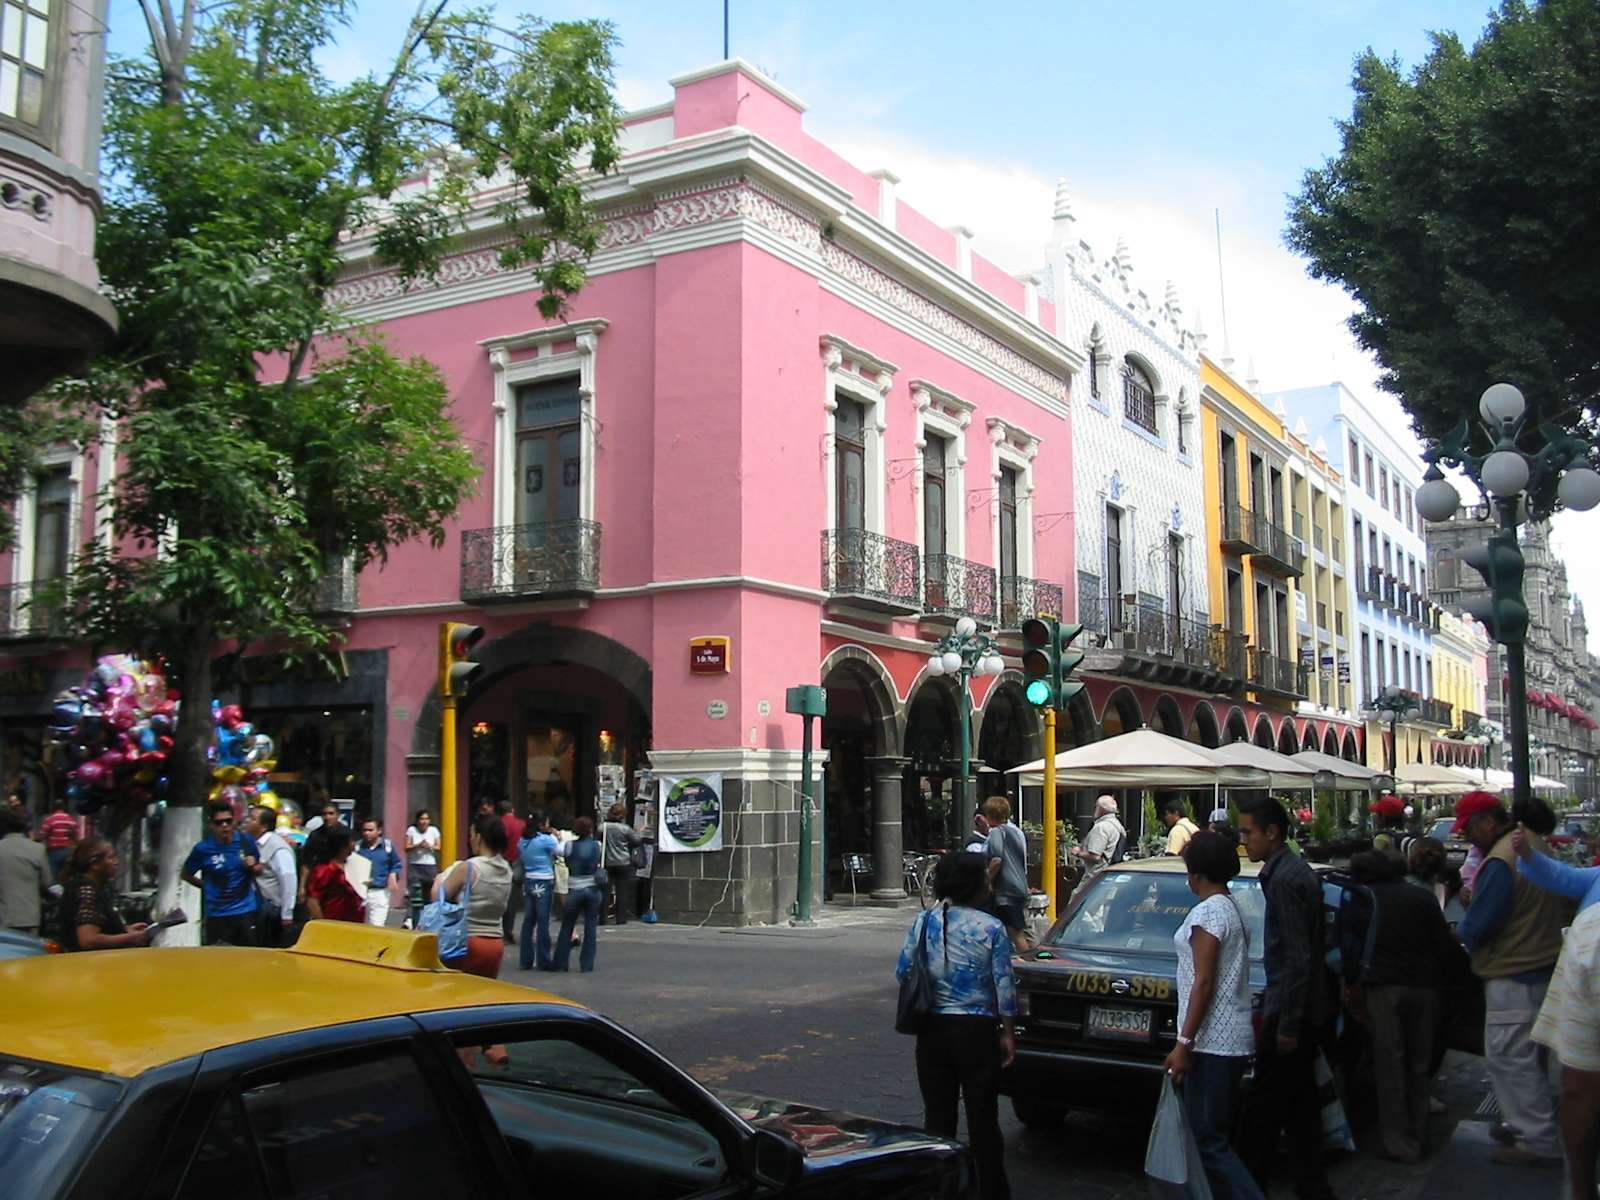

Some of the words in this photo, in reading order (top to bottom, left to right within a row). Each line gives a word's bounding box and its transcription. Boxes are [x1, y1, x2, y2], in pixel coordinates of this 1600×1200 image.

[707, 655, 720, 663] Mayo
[1066, 970, 1110, 993] 7033
[1131, 976, 1169, 998] SSB
